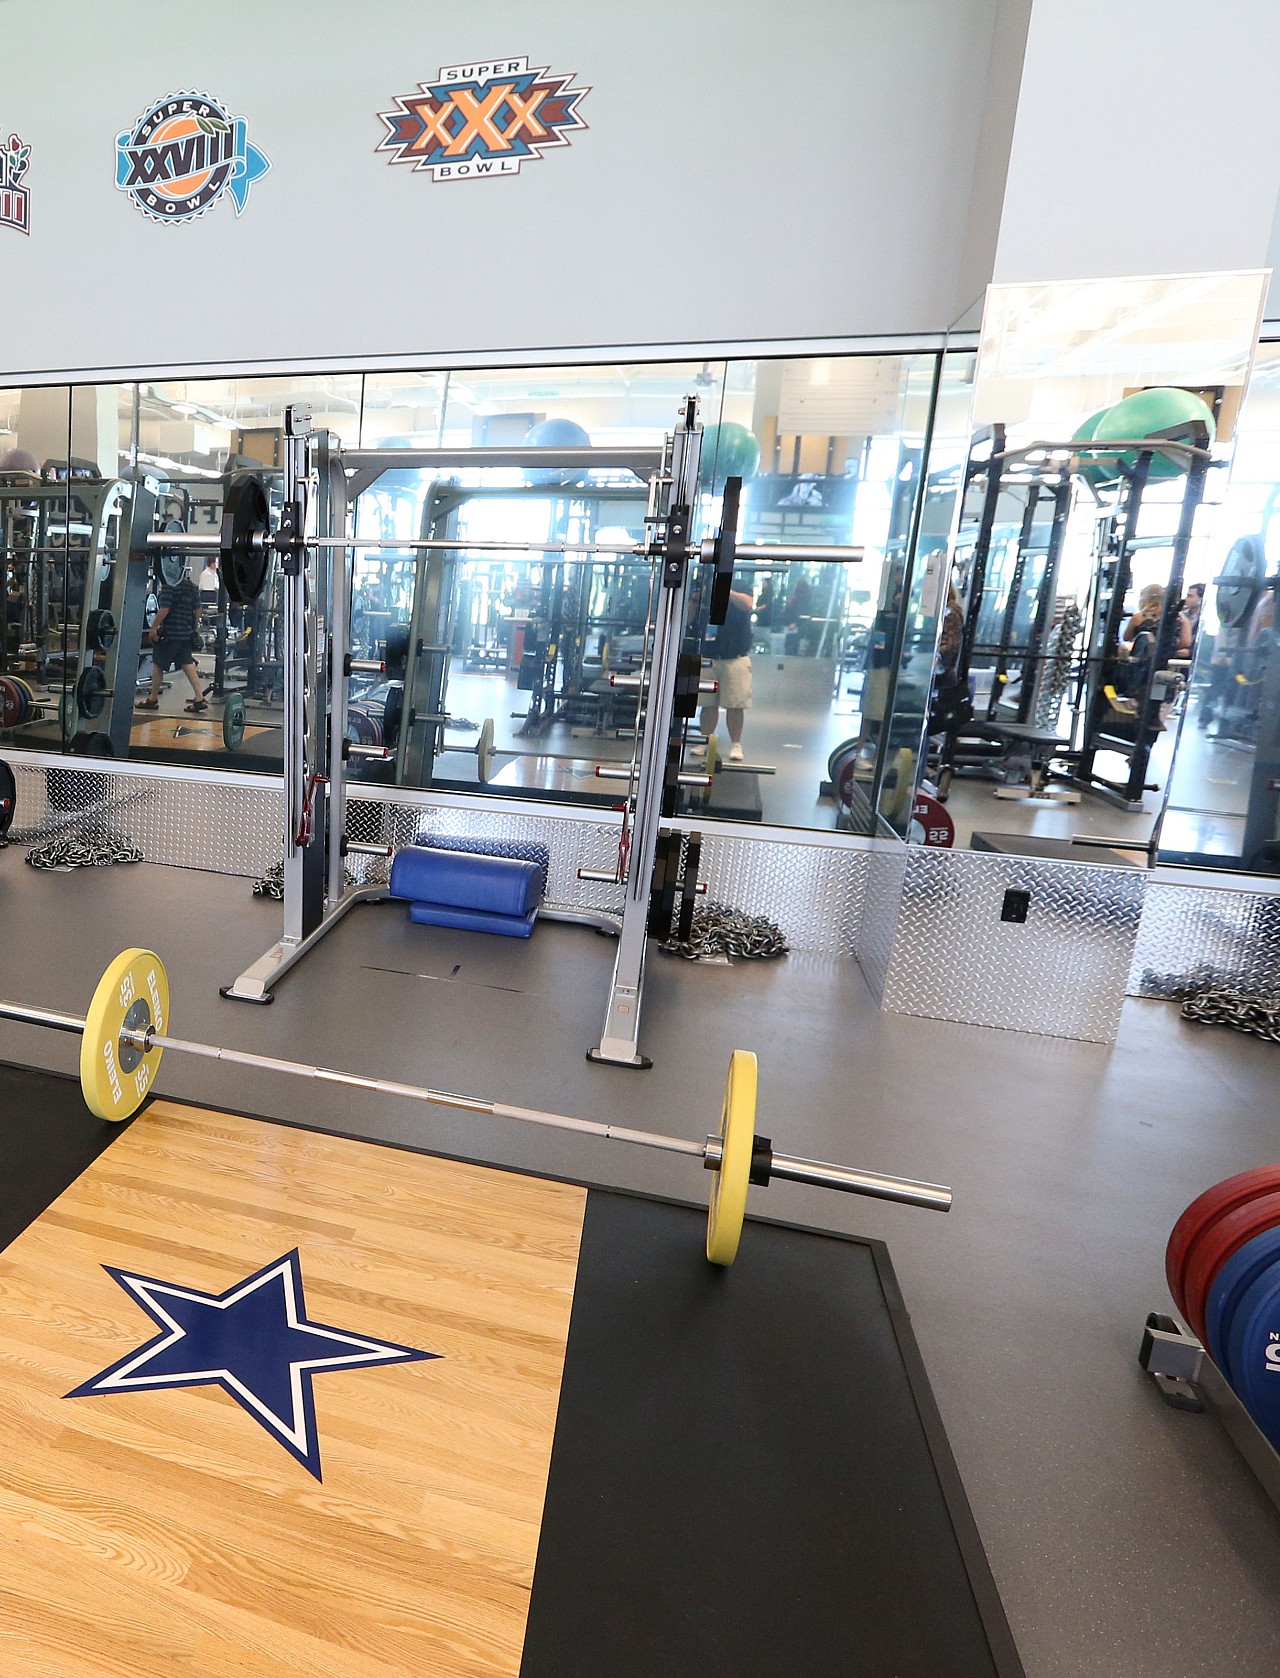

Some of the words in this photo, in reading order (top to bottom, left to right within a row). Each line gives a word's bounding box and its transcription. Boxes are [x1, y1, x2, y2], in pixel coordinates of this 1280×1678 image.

[446, 62, 521, 81] SUPER
[141, 101, 210, 137] SUPER
[412, 84, 549, 157] XXX
[126, 124, 234, 186] XXVIII
[439, 160, 513, 177] BOWL
[146, 181, 220, 213] BOWL
[121, 975, 133, 1008] 35
[146, 969, 163, 1032] ELEIKO
[103, 1040, 123, 1105] ELEIKO
